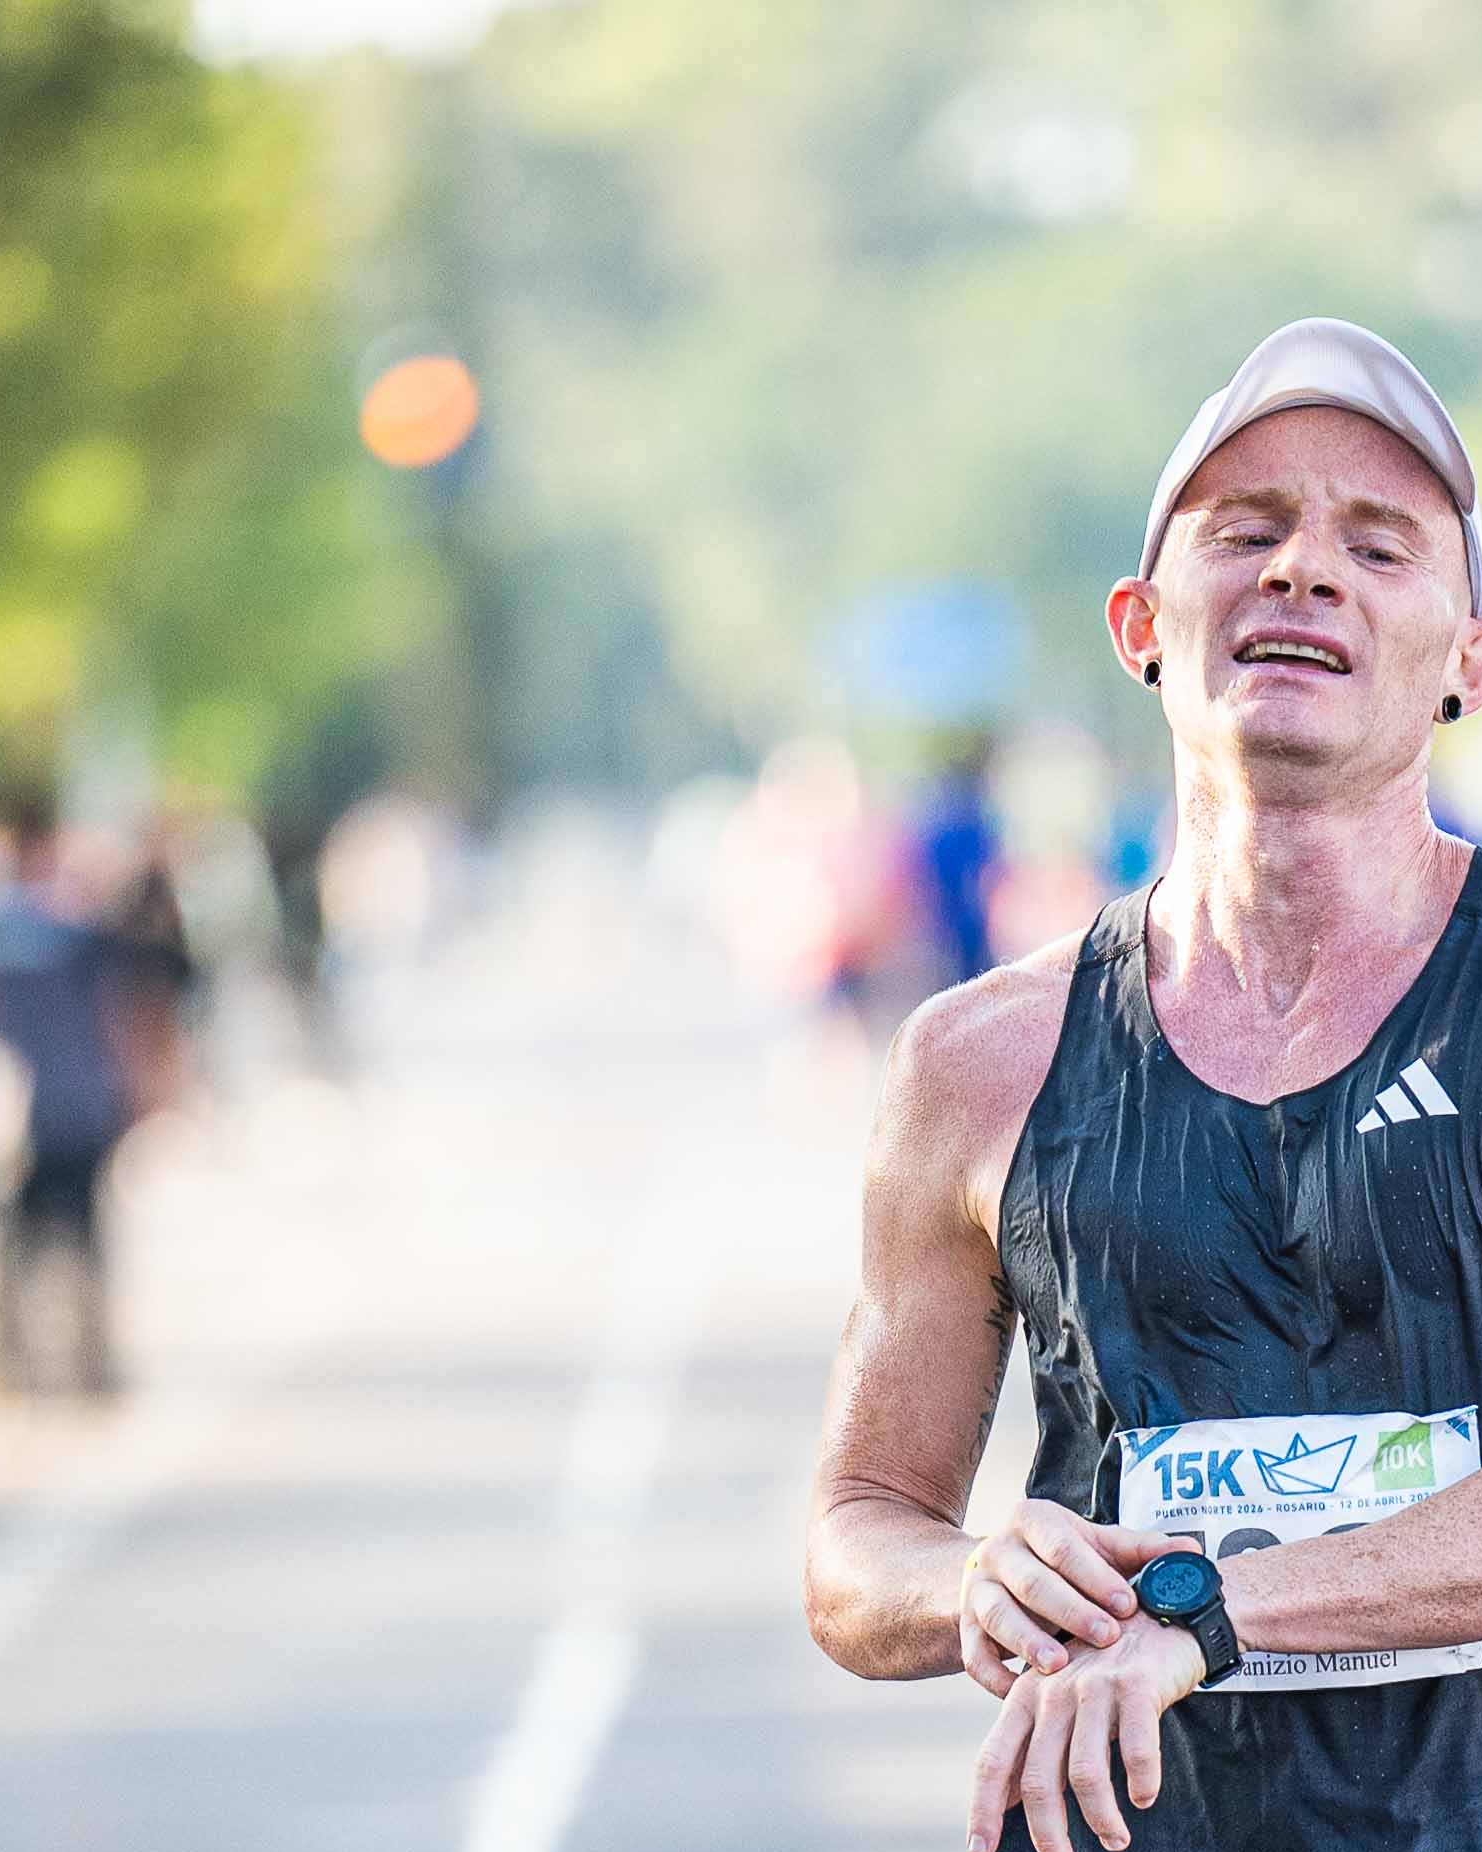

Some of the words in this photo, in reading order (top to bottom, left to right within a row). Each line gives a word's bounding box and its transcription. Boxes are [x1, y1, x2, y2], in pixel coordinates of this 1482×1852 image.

[1380, 1440, 1428, 1472] 10K
[1153, 1449, 1246, 1501] 15K
[1155, 1505, 1198, 1520] PUERTO
[1201, 1504, 1233, 1515] NORTE
[1237, 1503, 1264, 1514] 2026
[1276, 1501, 1326, 1513] ROSARIO
[1340, 1500, 1352, 1509] 12
[1357, 1498, 1370, 1508] DE
[1374, 1496, 1406, 1508] ABRIL
[1410, 1491, 1436, 1503] 202
[1237, 1654, 1307, 1677] anizio
[1315, 1650, 1398, 1673] Manuel
